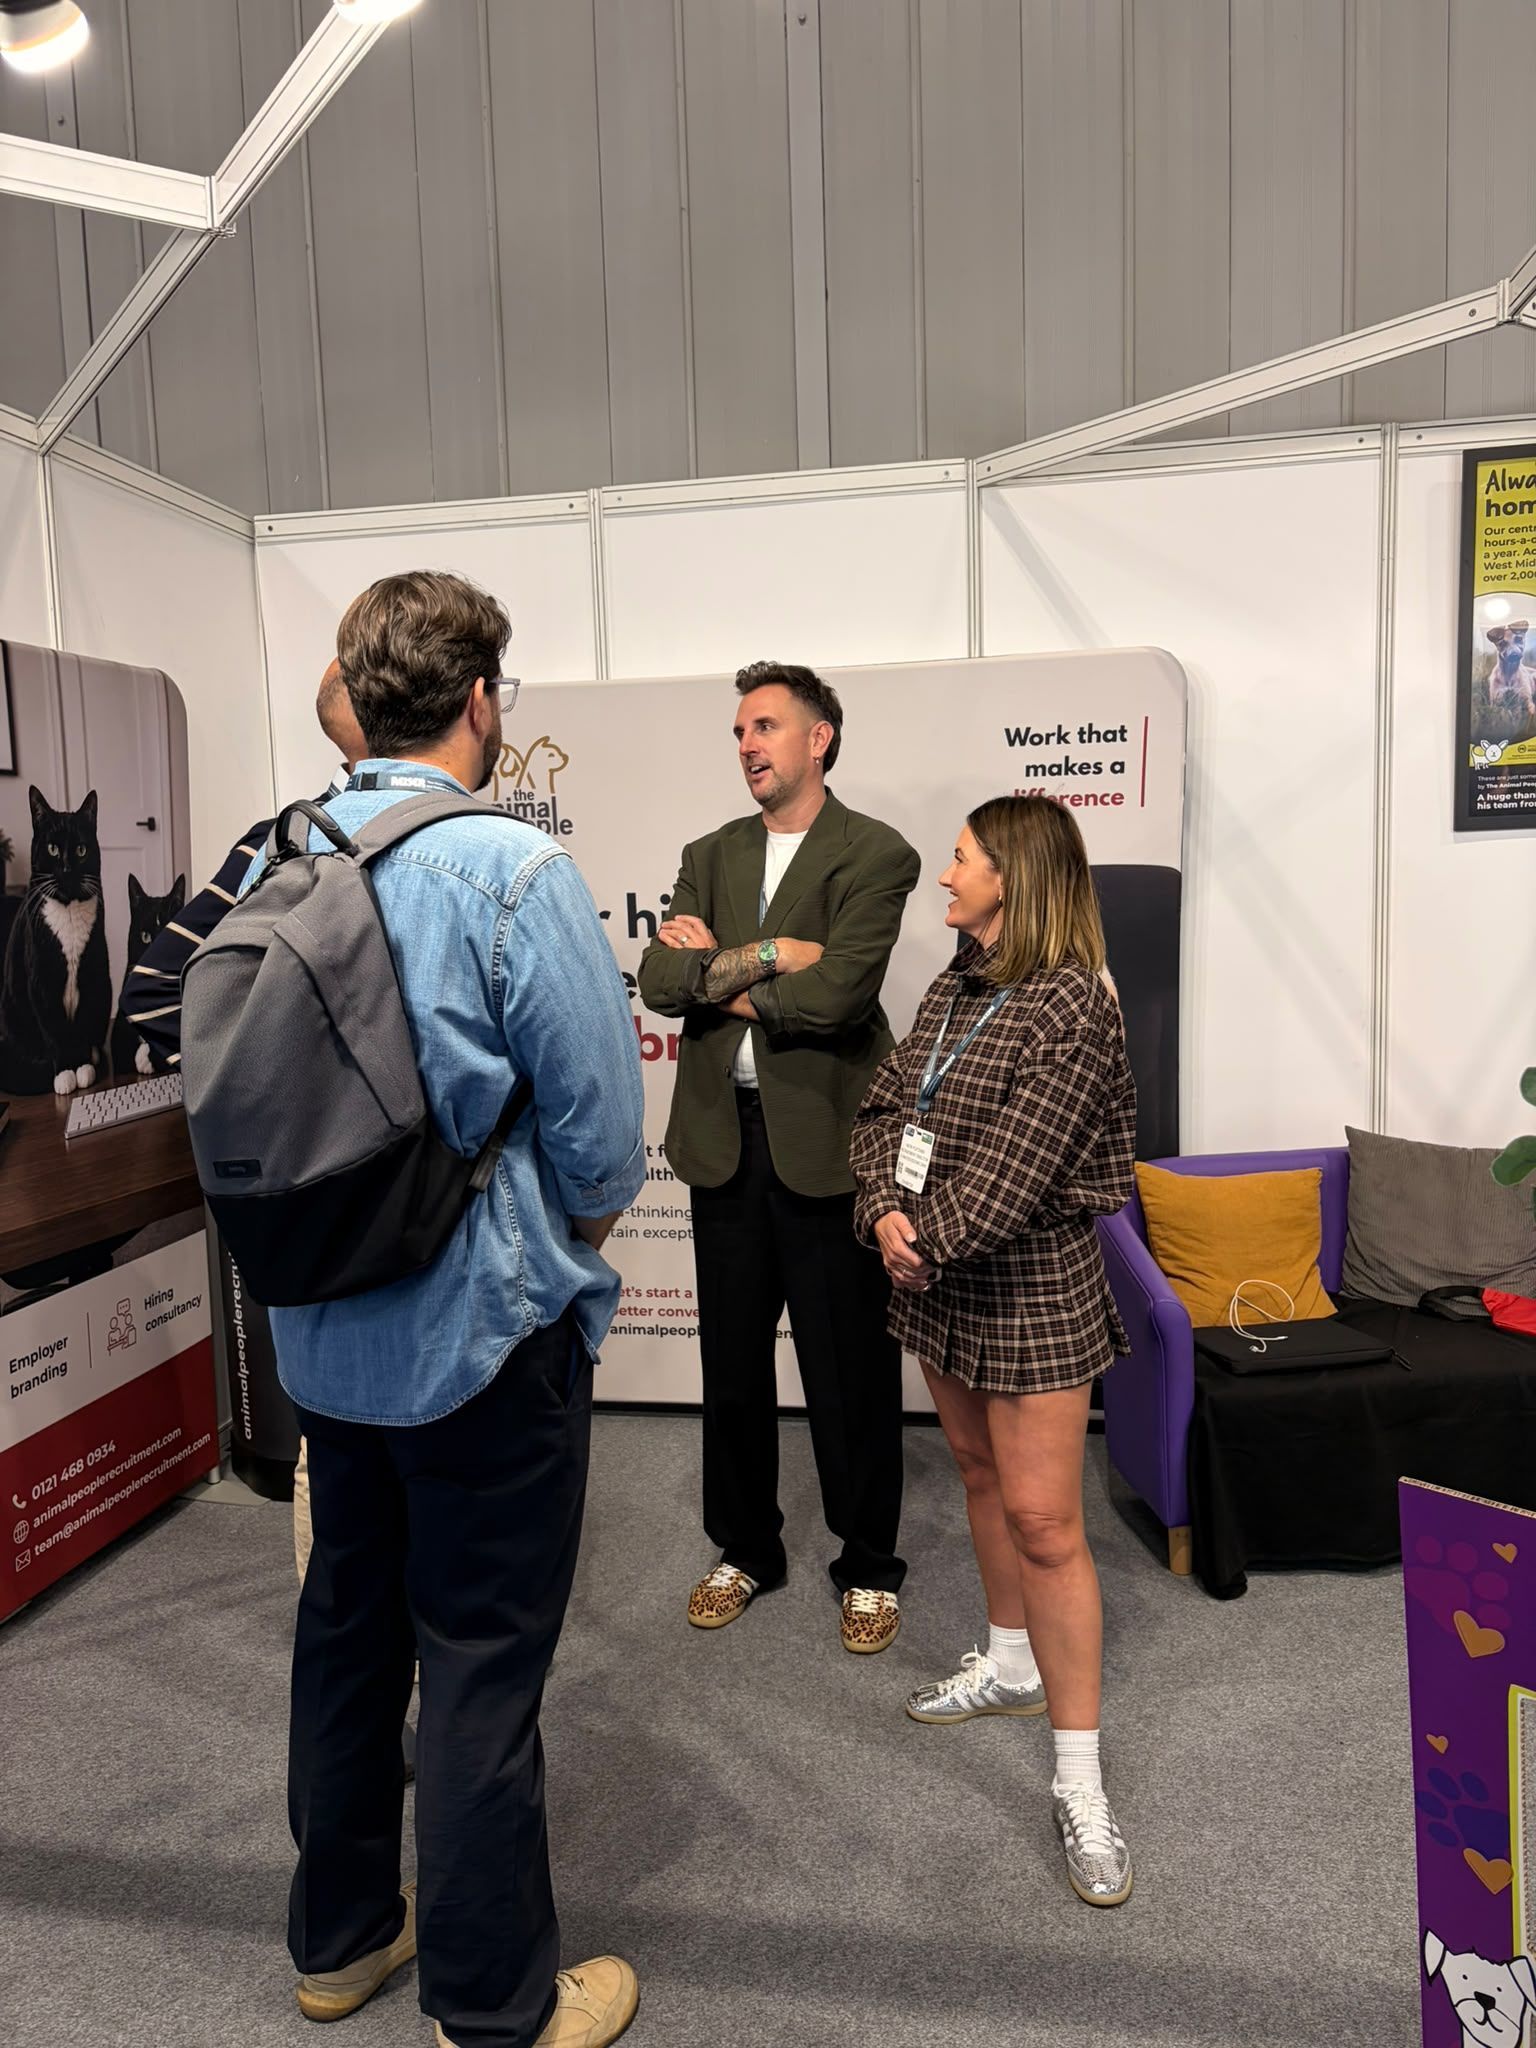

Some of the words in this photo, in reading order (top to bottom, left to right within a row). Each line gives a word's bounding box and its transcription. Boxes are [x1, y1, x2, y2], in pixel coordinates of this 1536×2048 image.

[1484, 527, 1505, 536] Our
[1493, 549, 1520, 560] year.
[1484, 561, 1512, 570] West
[1483, 574, 1507, 582] over
[1510, 570, 1536, 581] 2,00
[1004, 724, 1071, 747] Work
[1077, 723, 1128, 744] that
[1025, 755, 1103, 778] makes
[1110, 760, 1125, 774] a
[513, 789, 535, 801] the
[1477, 793, 1485, 801] A
[1487, 793, 1511, 802] huge
[1477, 801, 1491, 810] his
[144, 1287, 174, 1311] Hiring
[646, 1287, 680, 1298] start
[684, 1289, 693, 1299] a
[145, 1294, 202, 1332] consultancy
[615, 1306, 654, 1317] etter
[9, 1336, 69, 1374] Employer
[10, 1361, 68, 1399] branding
[31, 1474, 58, 1500] 0121
[60, 1458, 85, 1483] 468
[86, 1439, 116, 1467] 0934
[33, 1427, 182, 1529] animalpeoplerecruitment.com
[34, 1432, 211, 1556] team@animalpeoplerecruitment.com
